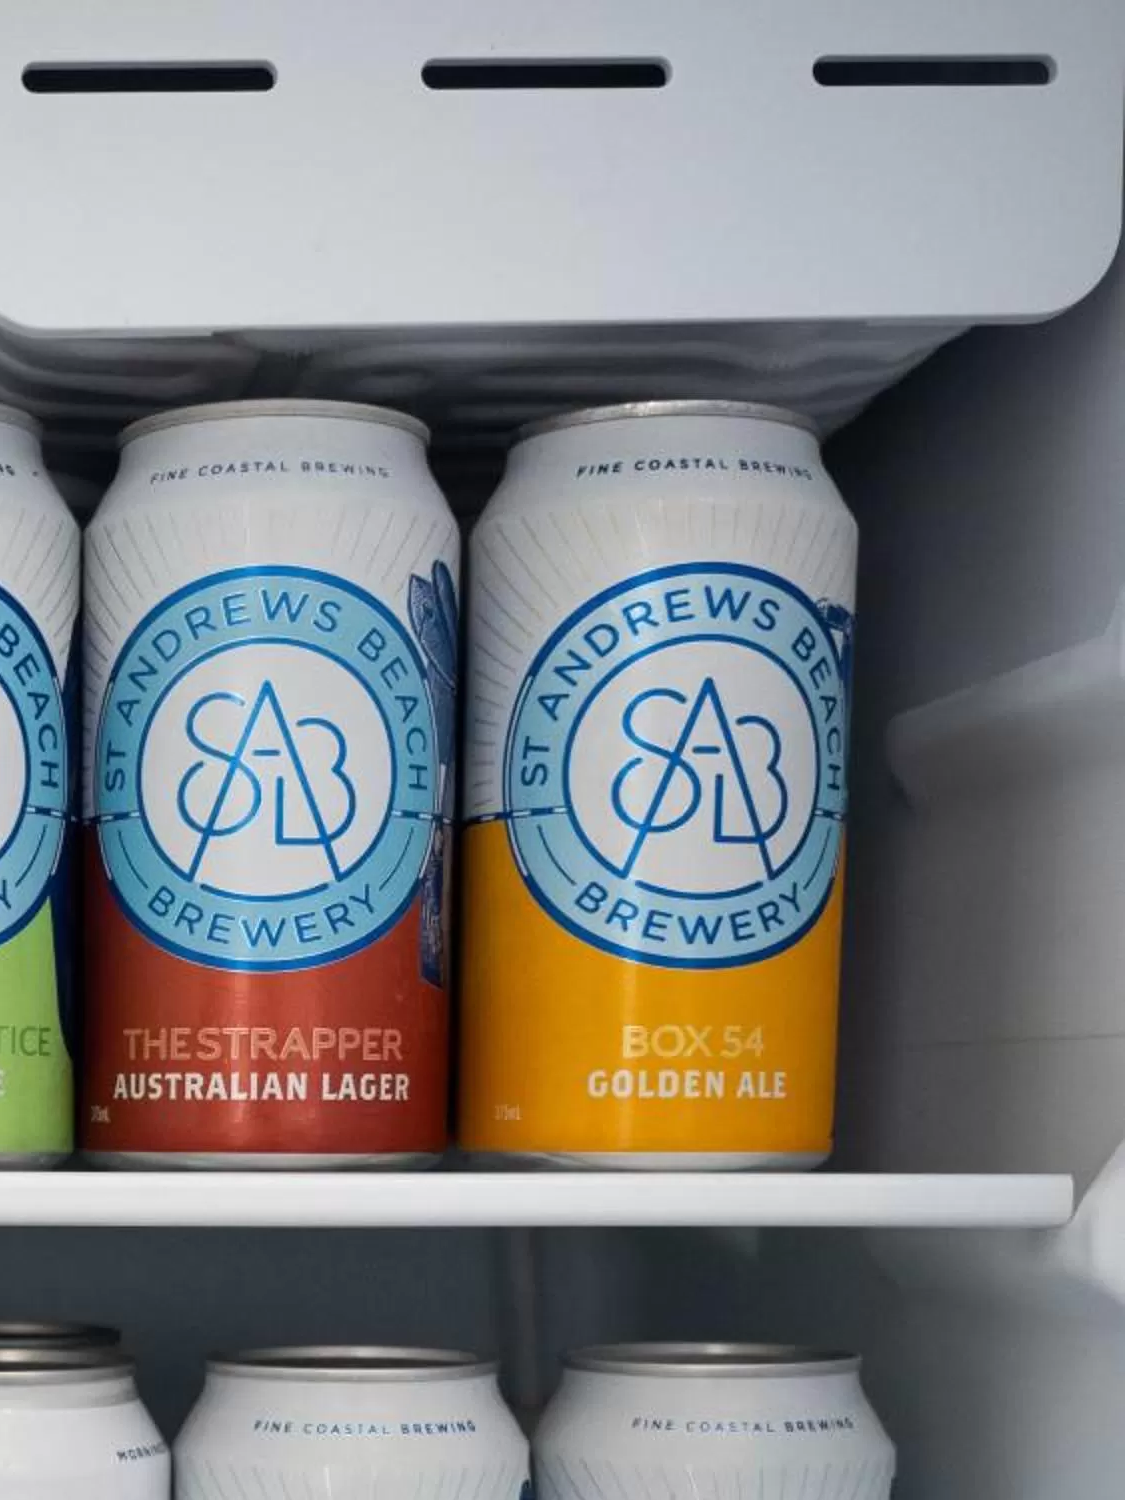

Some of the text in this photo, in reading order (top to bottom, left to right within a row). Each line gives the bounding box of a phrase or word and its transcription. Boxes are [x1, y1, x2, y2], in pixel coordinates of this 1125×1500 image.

[150, 461, 393, 485] FINE COASTAL BREWING
[576, 457, 812, 480] FINE COASTAL BREWING
[105, 589, 428, 792] ST ANDREWS BEACH
[521, 585, 841, 791] ST ANDREWS BEACH
[148, 883, 375, 949] BREWERY
[575, 881, 802, 944] BREWERY
[123, 1027, 403, 1062] THE STRAPPER
[622, 1024, 764, 1059] BOX 54
[114, 1072, 411, 1101] AUSTRALIAN LAGER
[588, 1069, 787, 1099] GOLDEN ALE
[254, 1419, 476, 1436] FINE COASTAL BREWING
[631, 1417, 854, 1433] FINE COASTAL BREWING
